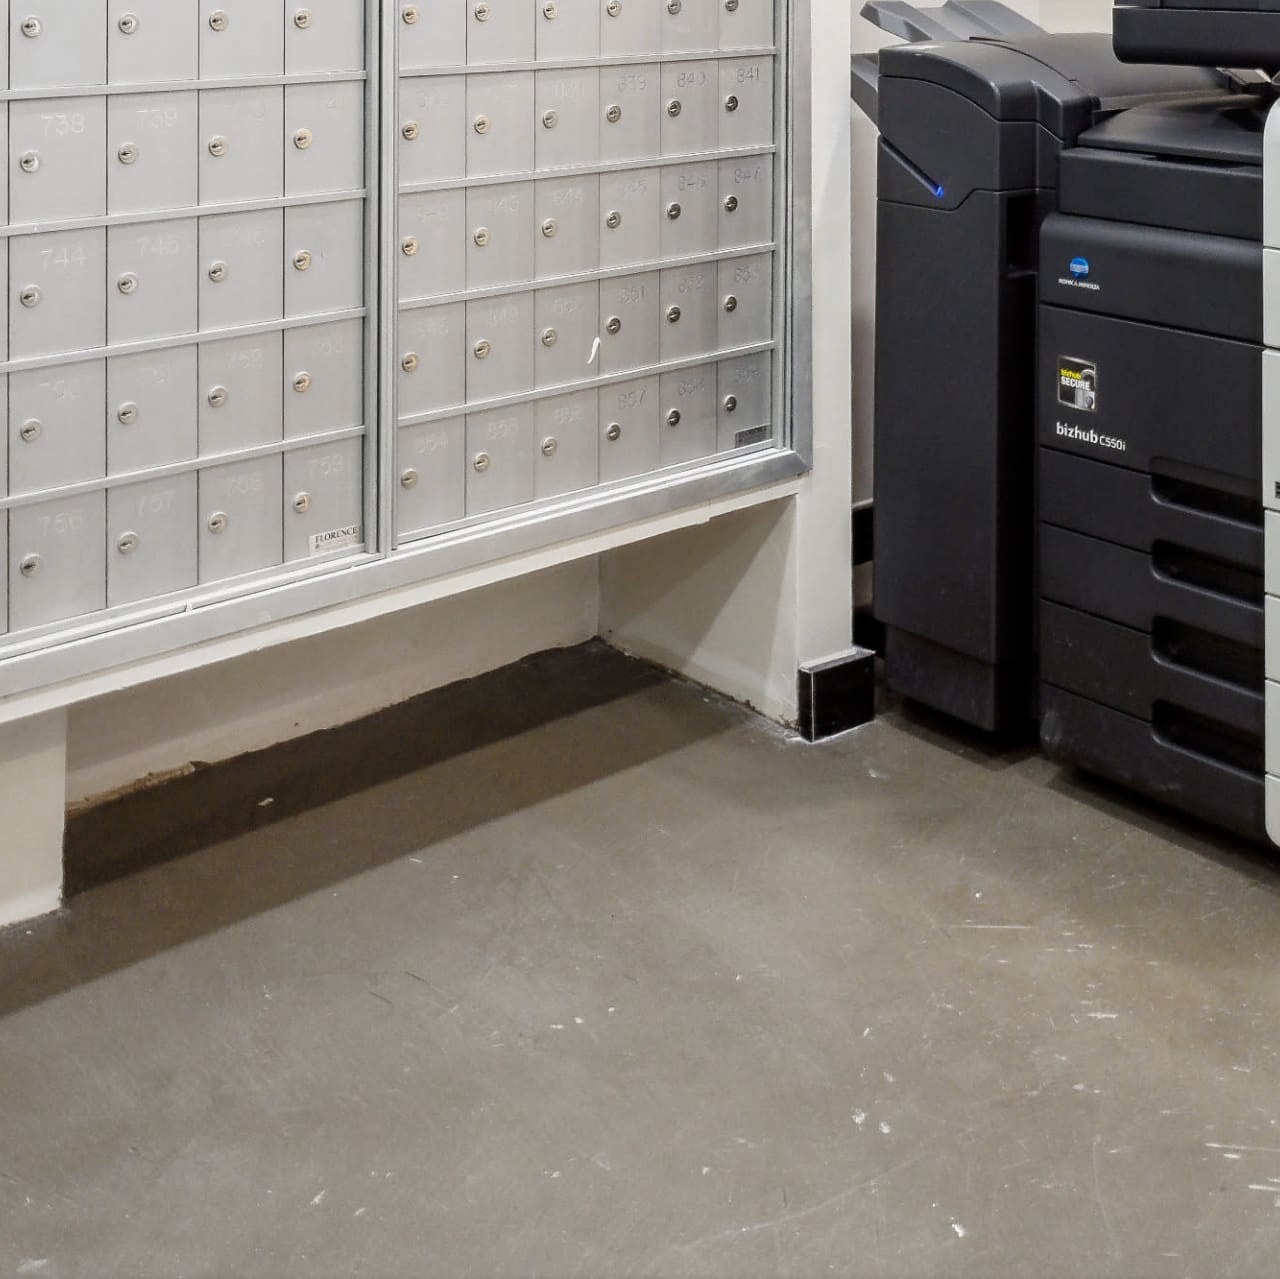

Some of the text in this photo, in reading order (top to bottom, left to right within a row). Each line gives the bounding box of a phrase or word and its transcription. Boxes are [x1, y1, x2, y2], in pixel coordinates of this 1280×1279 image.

[737, 67, 758, 82] 841
[40, 113, 84, 136] 738
[40, 246, 86, 269] 744
[1060, 375, 1090, 391] SECURE
[1056, 421, 1098, 444] bizhub
[315, 526, 359, 544] FLORENCE
